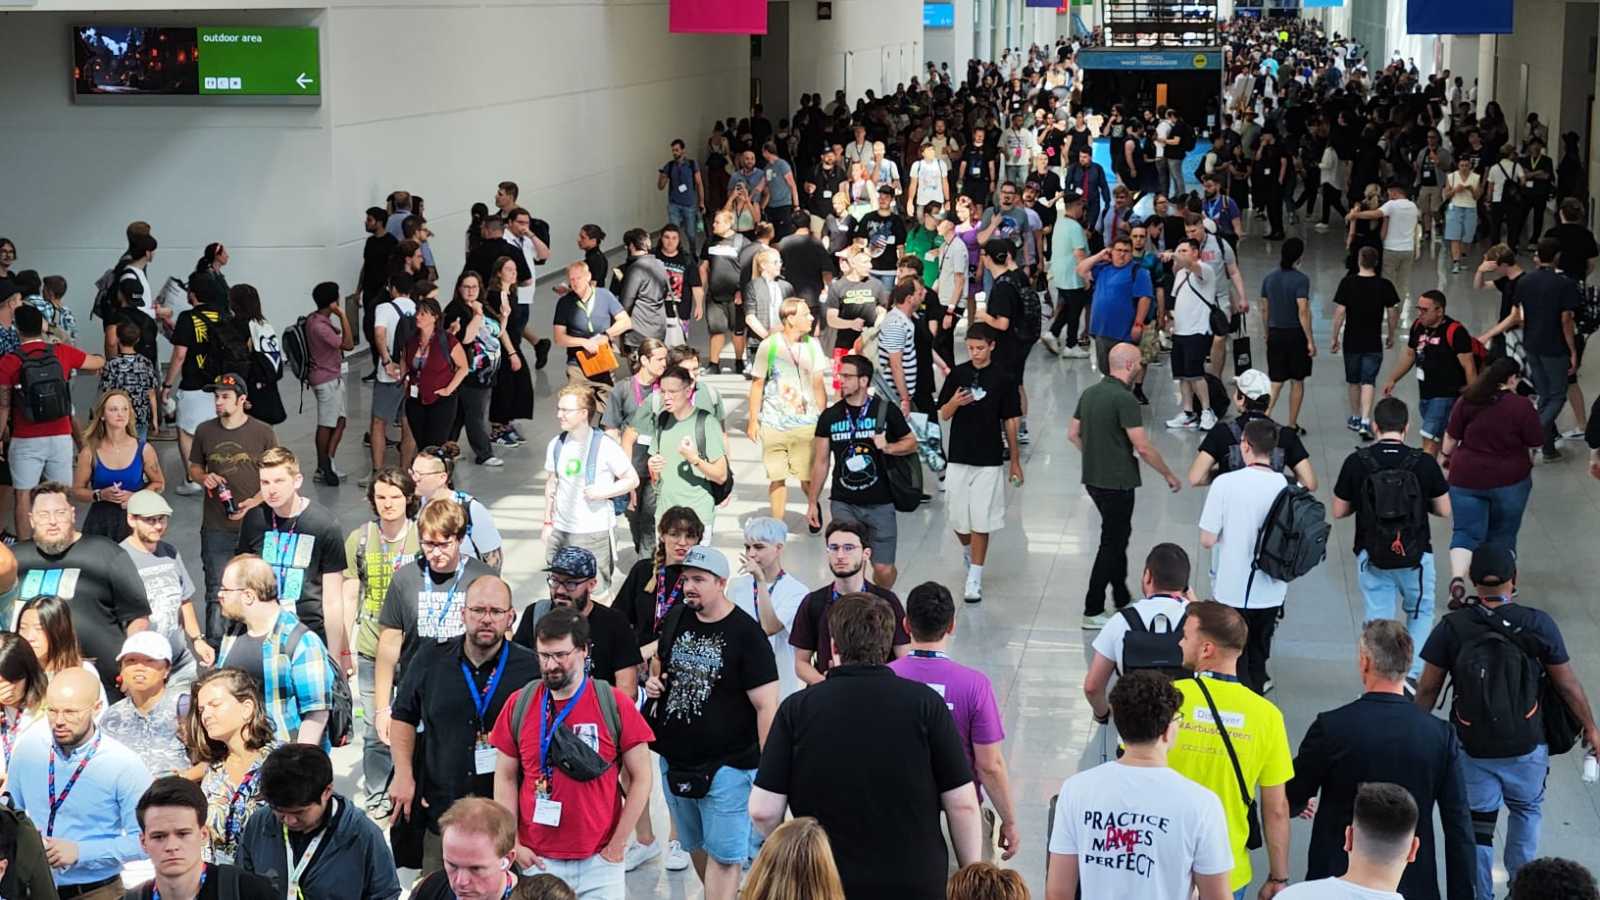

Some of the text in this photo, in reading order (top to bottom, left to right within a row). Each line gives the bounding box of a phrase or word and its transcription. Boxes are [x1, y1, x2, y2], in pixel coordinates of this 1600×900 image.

[203, 33, 239, 42] outdoor
[846, 289, 872, 297] GUCCI
[1084, 810, 1170, 834] PRACTICE
[1085, 853, 1155, 878] PERFECT
